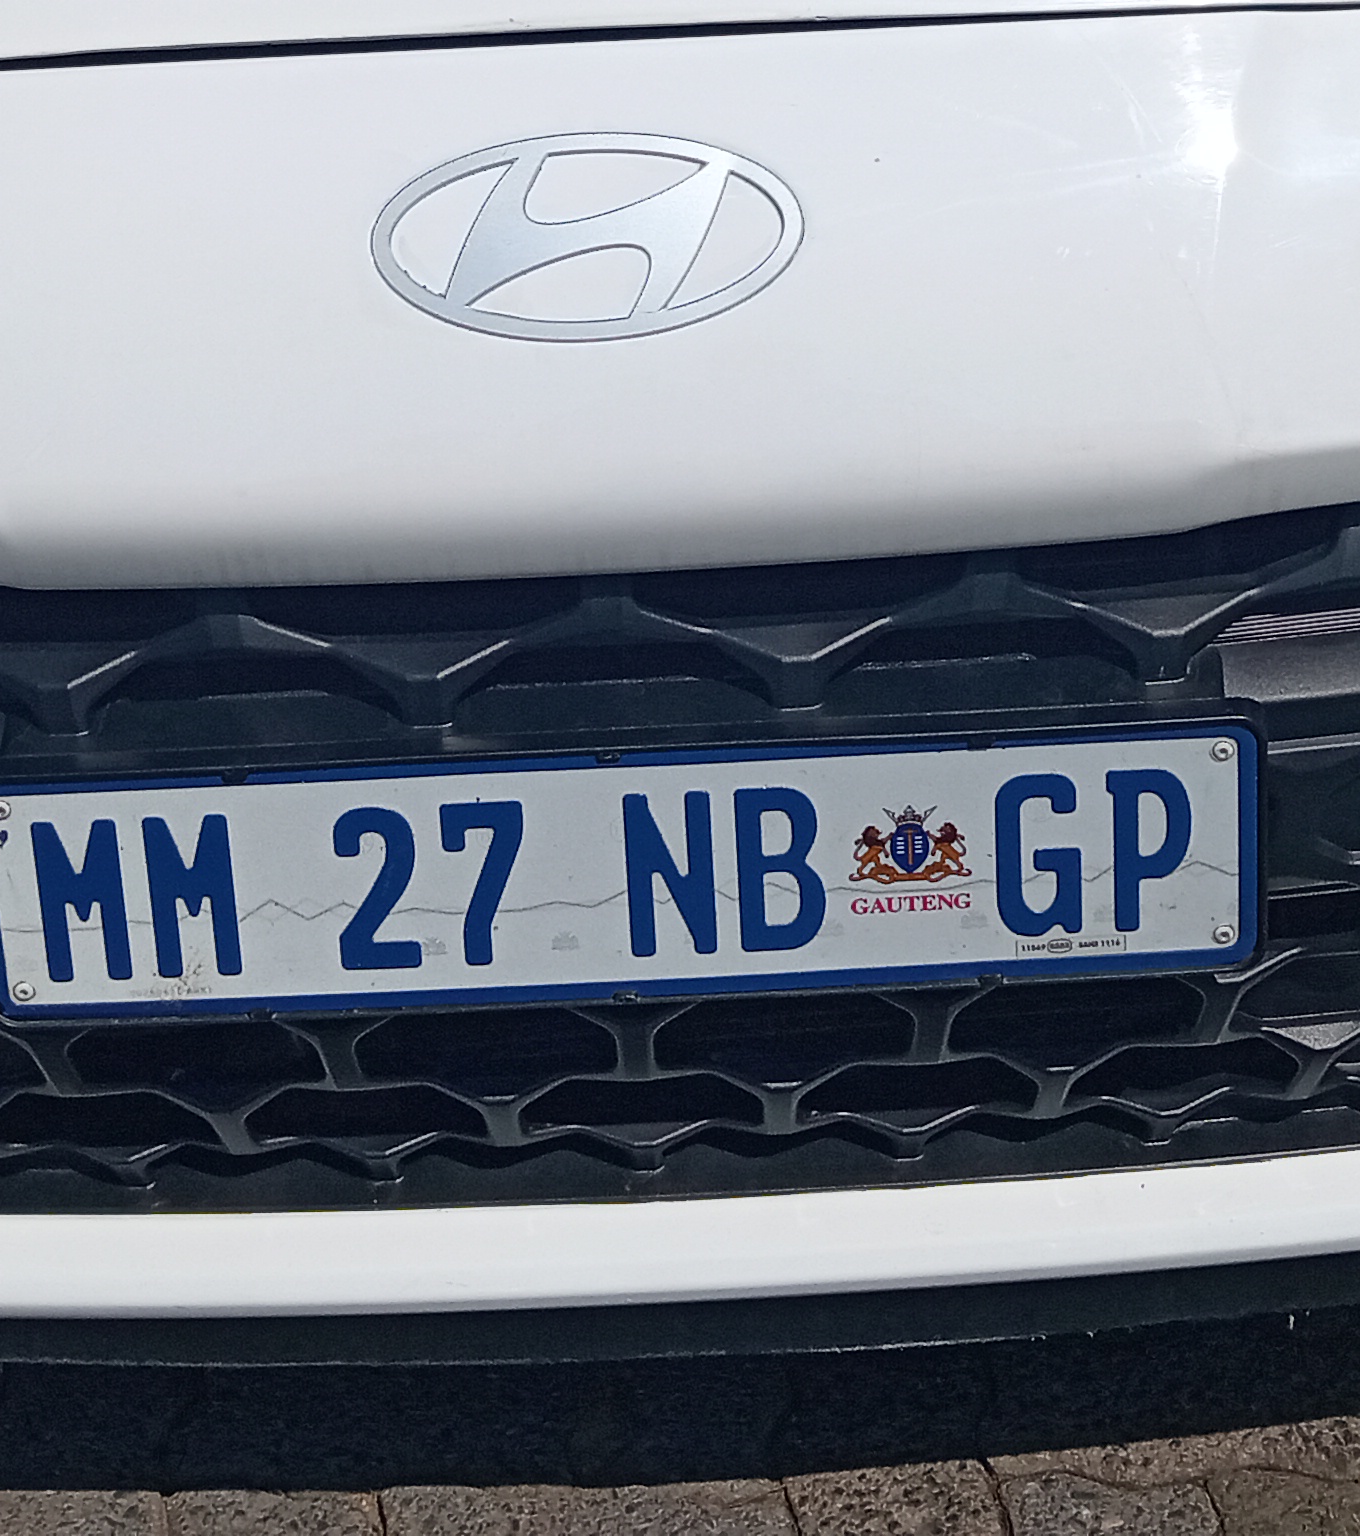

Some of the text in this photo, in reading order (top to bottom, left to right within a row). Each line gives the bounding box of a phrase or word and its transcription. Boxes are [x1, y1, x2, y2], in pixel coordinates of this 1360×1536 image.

[30, 767, 1193, 982] MM 27 NB GP
[850, 892, 972, 915] GAUTENG
